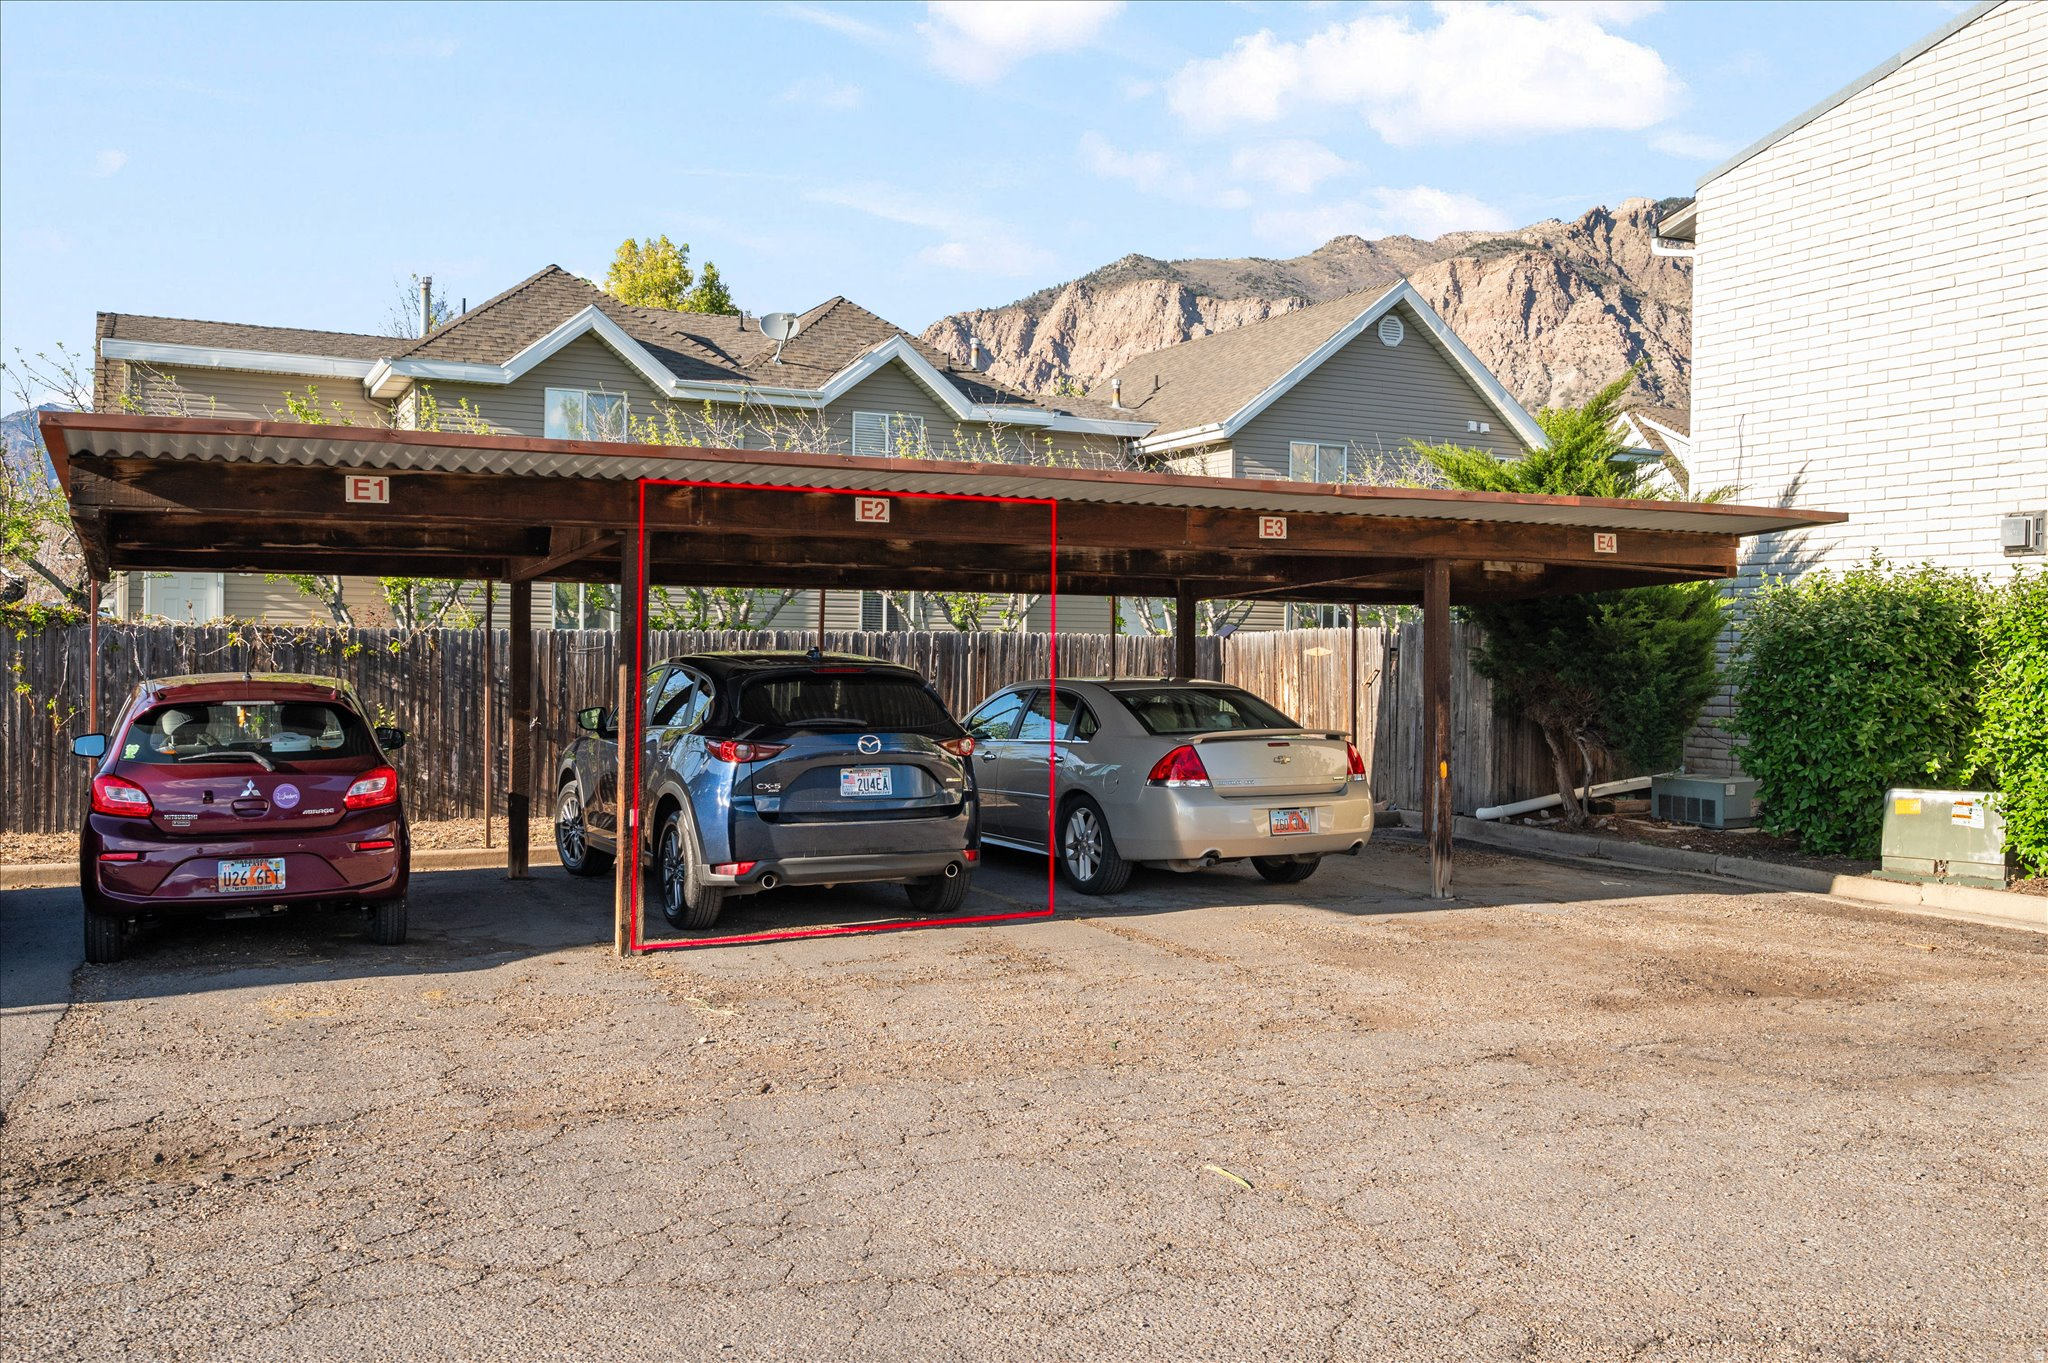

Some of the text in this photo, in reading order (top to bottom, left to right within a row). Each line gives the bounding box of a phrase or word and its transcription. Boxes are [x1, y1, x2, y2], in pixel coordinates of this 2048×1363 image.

[353, 479, 384, 501] E1
[861, 500, 886, 520] E2
[1264, 519, 1284, 537] E3
[1597, 535, 1614, 551] E4
[756, 782, 781, 790] CX-5
[857, 777, 889, 792] 2U4EA
[223, 868, 280, 887] U26 6ET
